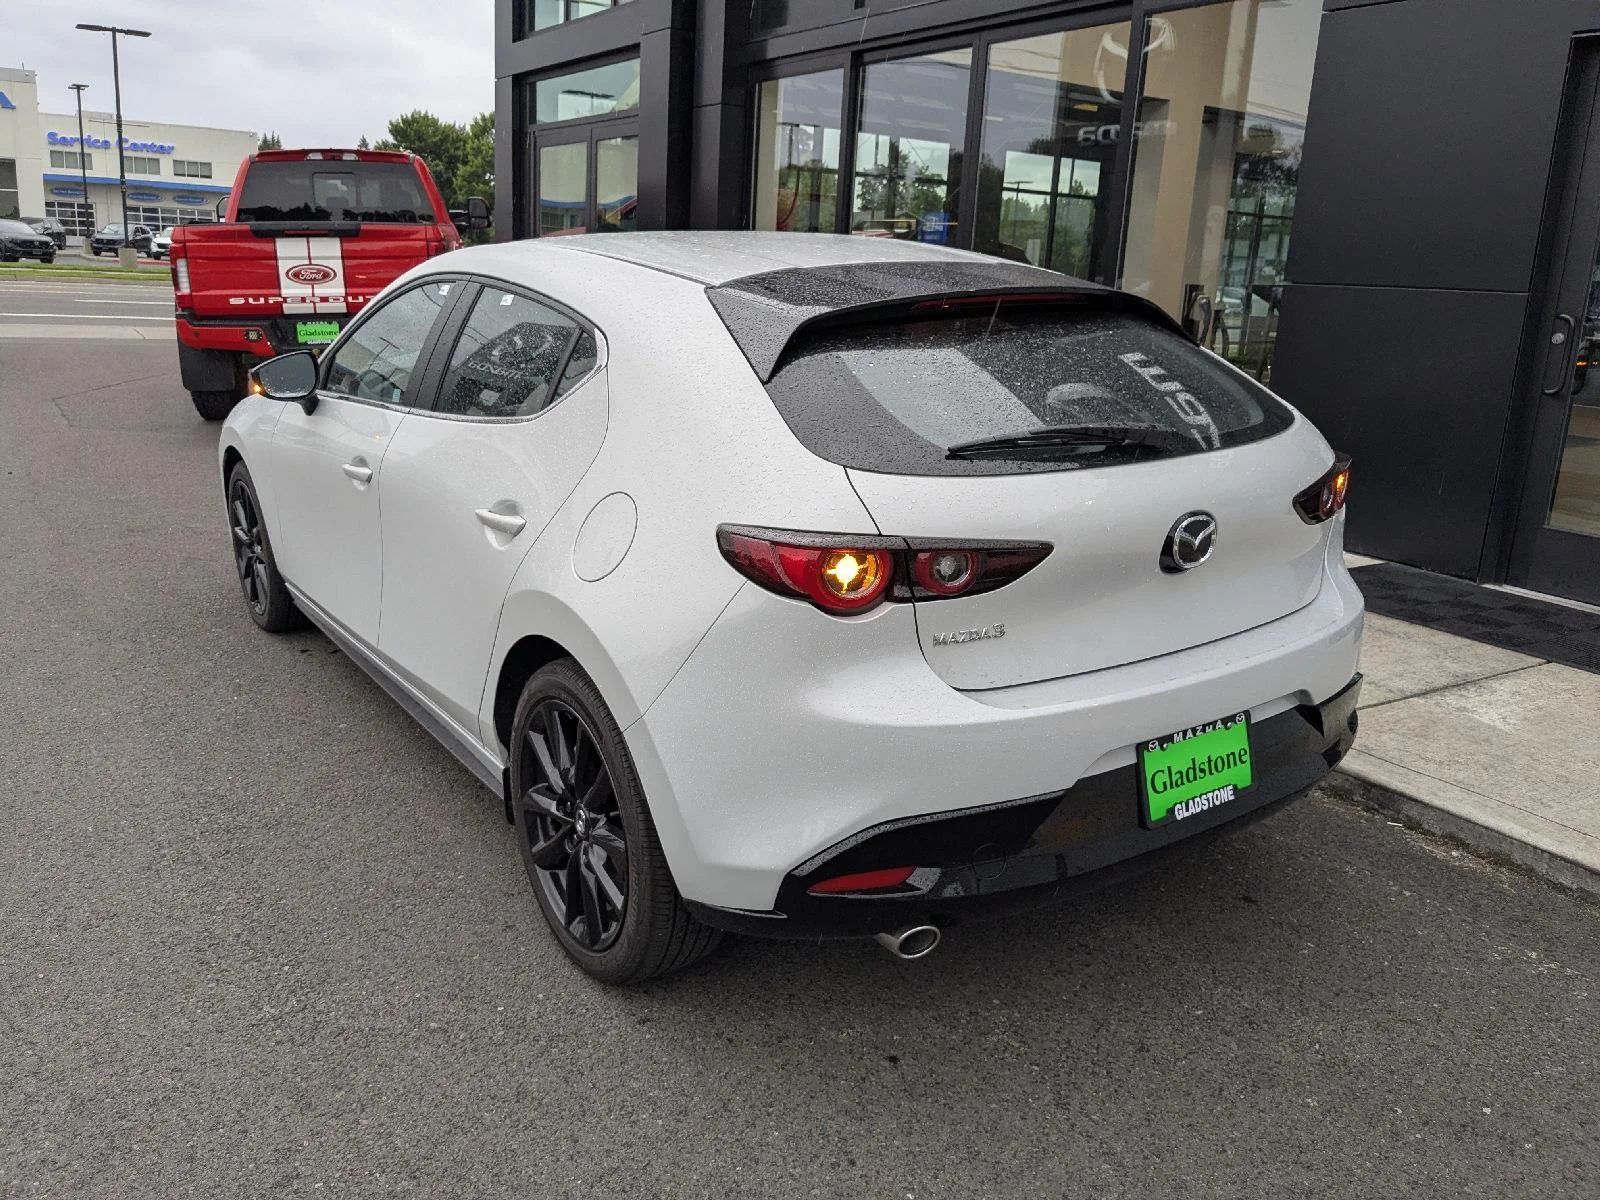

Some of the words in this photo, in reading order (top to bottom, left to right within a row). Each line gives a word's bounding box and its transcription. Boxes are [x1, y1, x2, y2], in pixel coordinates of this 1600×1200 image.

[47, 131, 111, 149] Service
[116, 137, 175, 154] Center
[299, 269, 324, 280] Ford
[229, 296, 321, 305] SUPER
[299, 328, 339, 338] Gladstone
[932, 623, 1006, 648] MAZDA3
[1173, 719, 1224, 744] MAZDA
[1150, 747, 1248, 795] Gladstone
[1174, 784, 1235, 820] GLADSTONE
